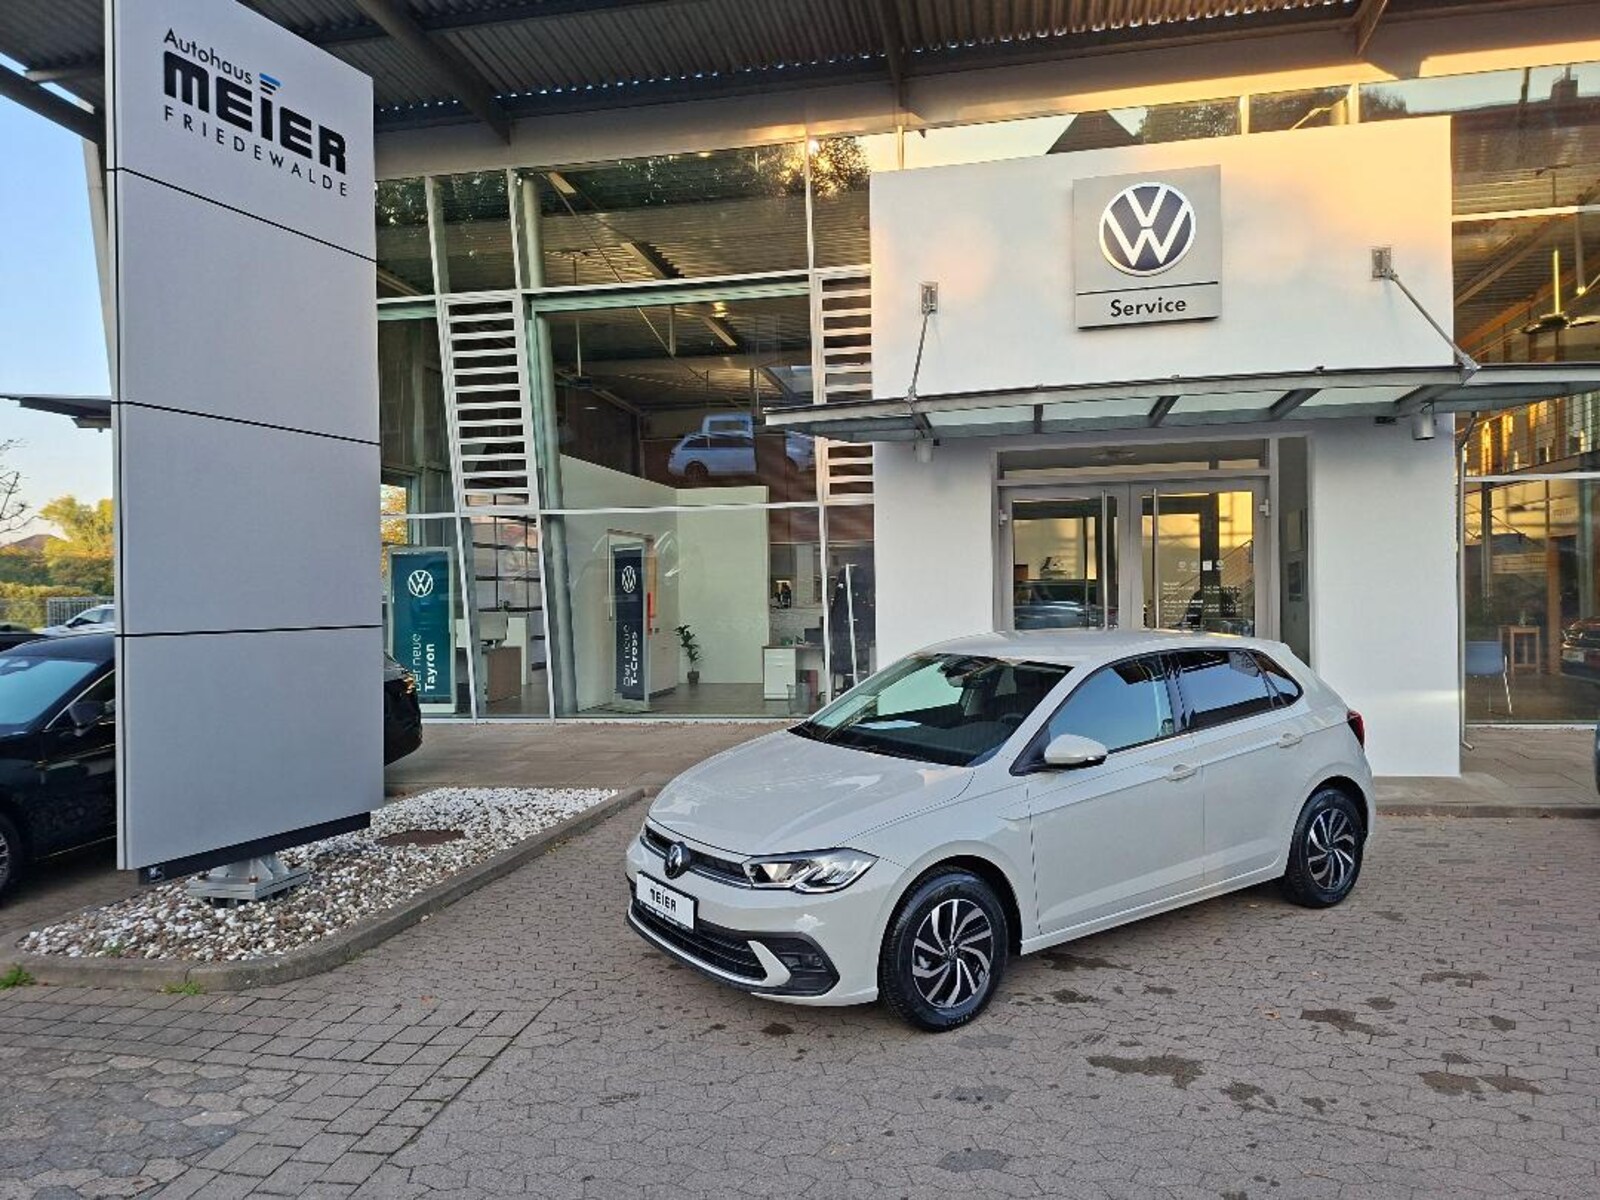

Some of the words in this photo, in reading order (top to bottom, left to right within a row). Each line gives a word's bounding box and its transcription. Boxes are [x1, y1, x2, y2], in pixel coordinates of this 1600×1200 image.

[163, 28, 253, 85] Autohaus
[164, 105, 348, 197] FRIEDEWALDE
[1099, 181, 1197, 277] VW
[1110, 296, 1187, 318] Service
[412, 633, 422, 666] neue
[424, 643, 438, 693] Tayron
[630, 631, 638, 687] T-Cross
